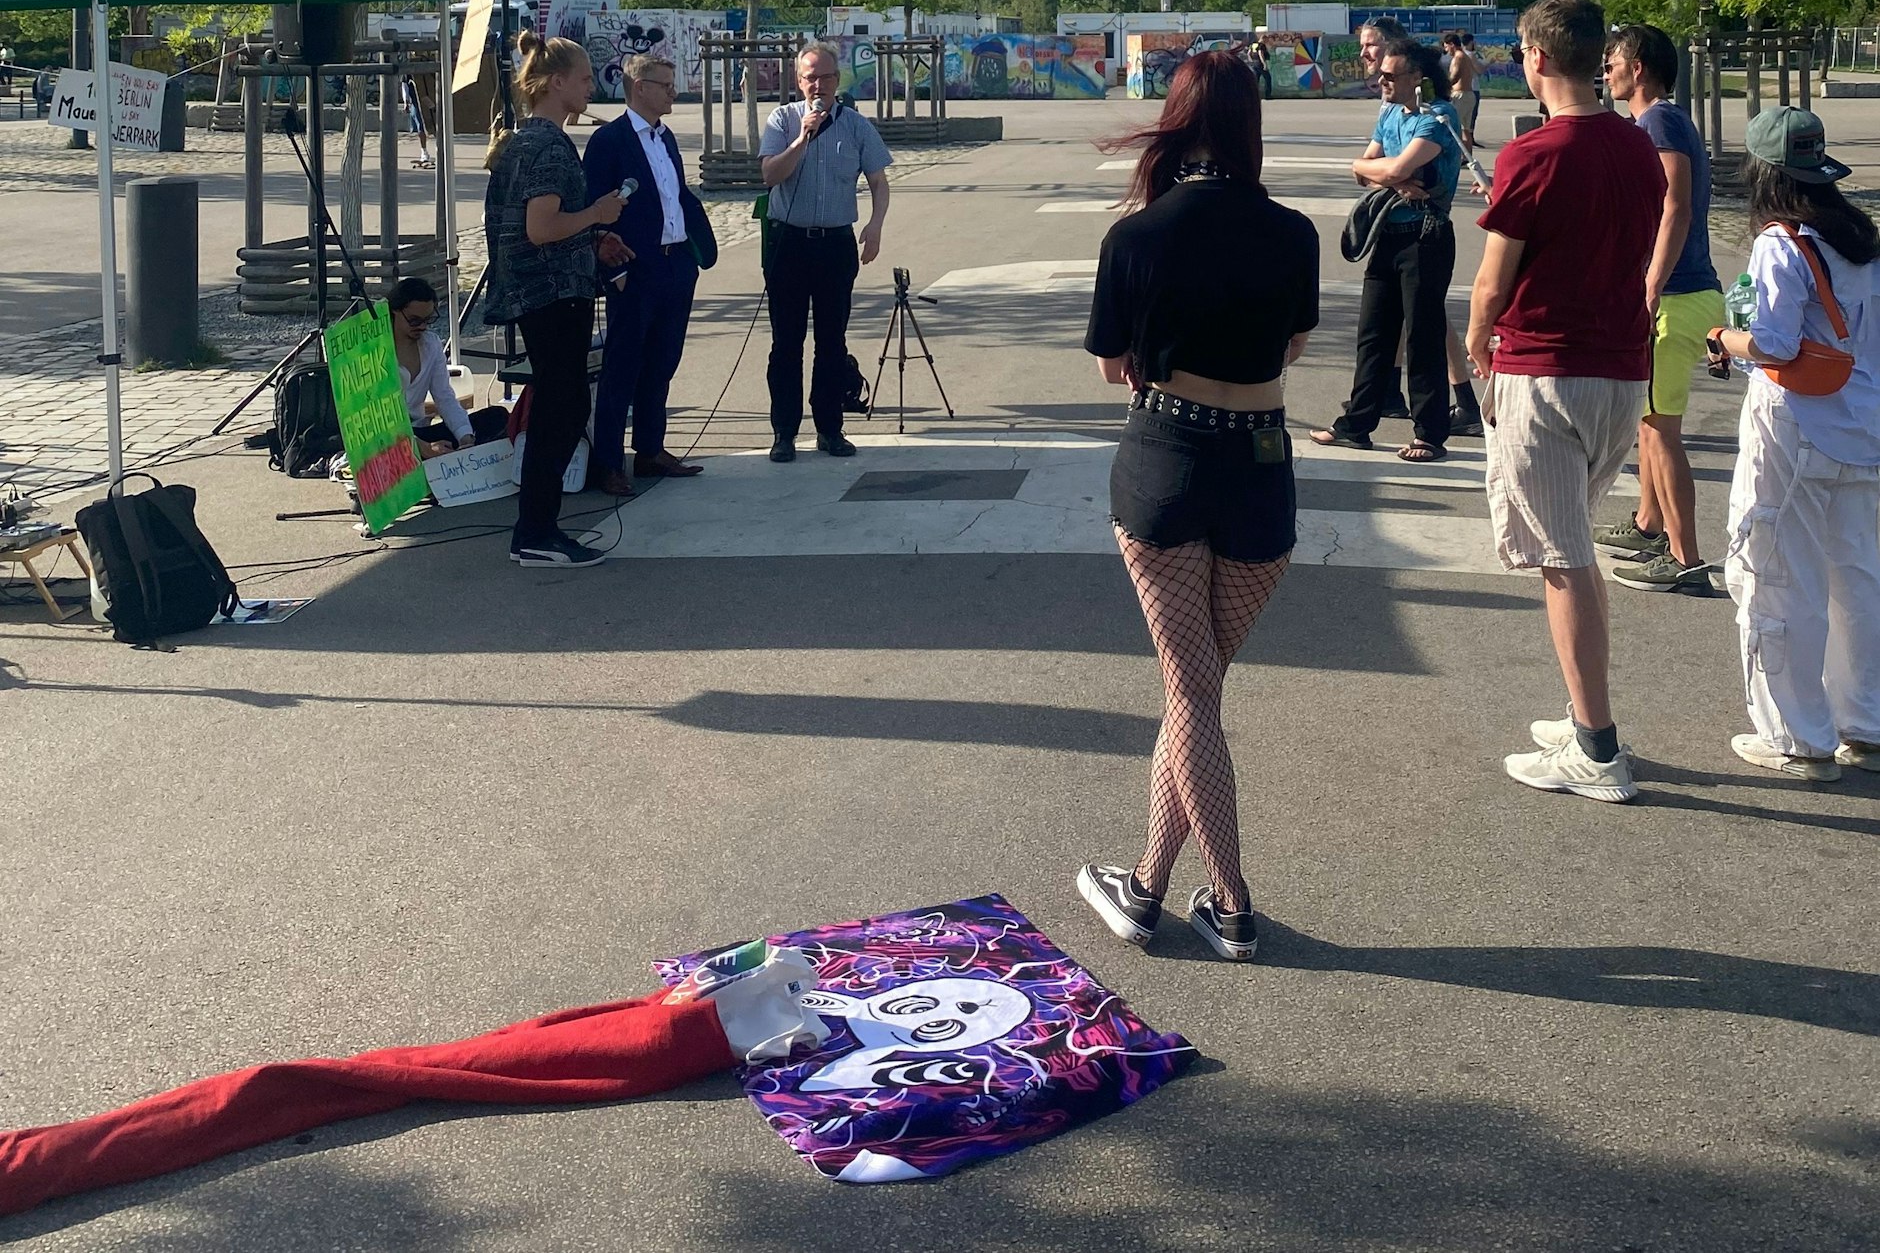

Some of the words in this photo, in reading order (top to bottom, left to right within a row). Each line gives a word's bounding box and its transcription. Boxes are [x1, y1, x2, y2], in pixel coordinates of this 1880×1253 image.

[117, 88, 152, 109] BERLIN
[339, 345, 389, 402] MUSIK
[343, 389, 405, 451] FREIHEIT
